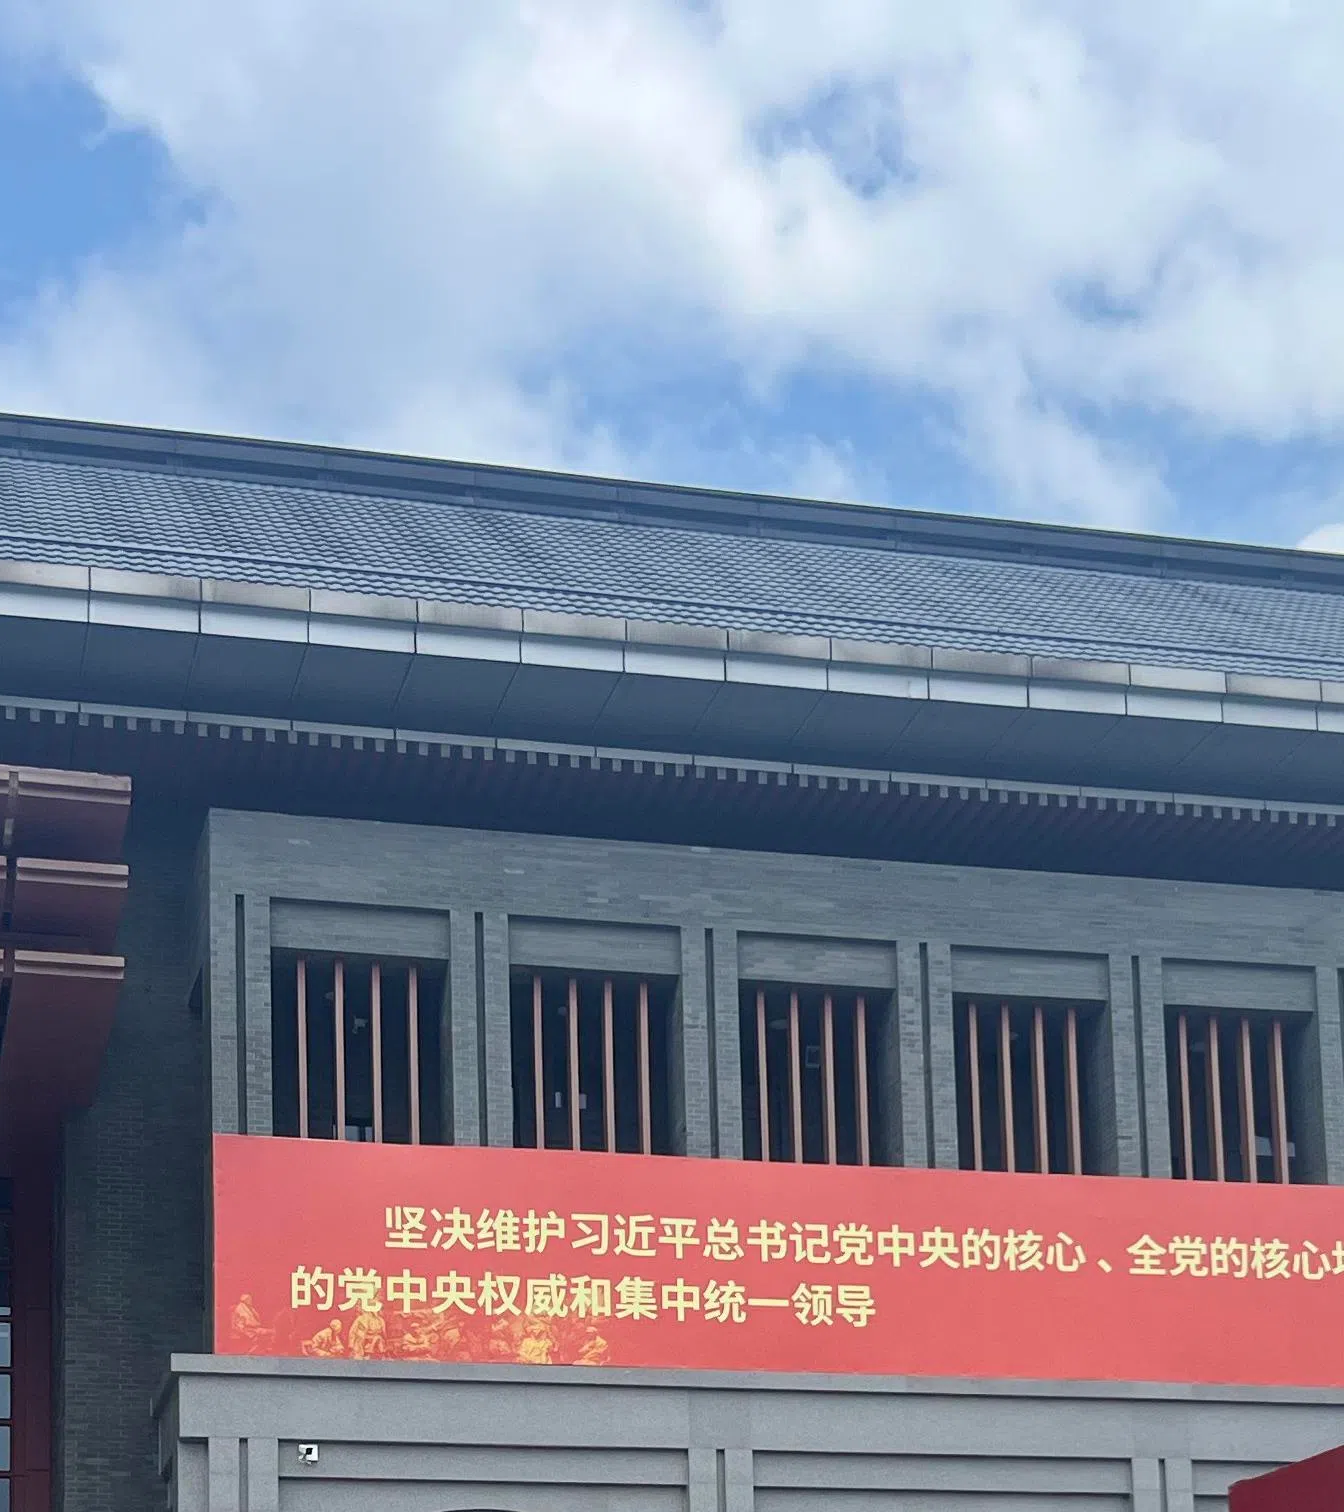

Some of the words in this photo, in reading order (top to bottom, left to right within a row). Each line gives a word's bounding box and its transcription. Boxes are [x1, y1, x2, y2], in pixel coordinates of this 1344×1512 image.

[289, 1266, 876, 1328] 的党中央权威和集中统一领导
